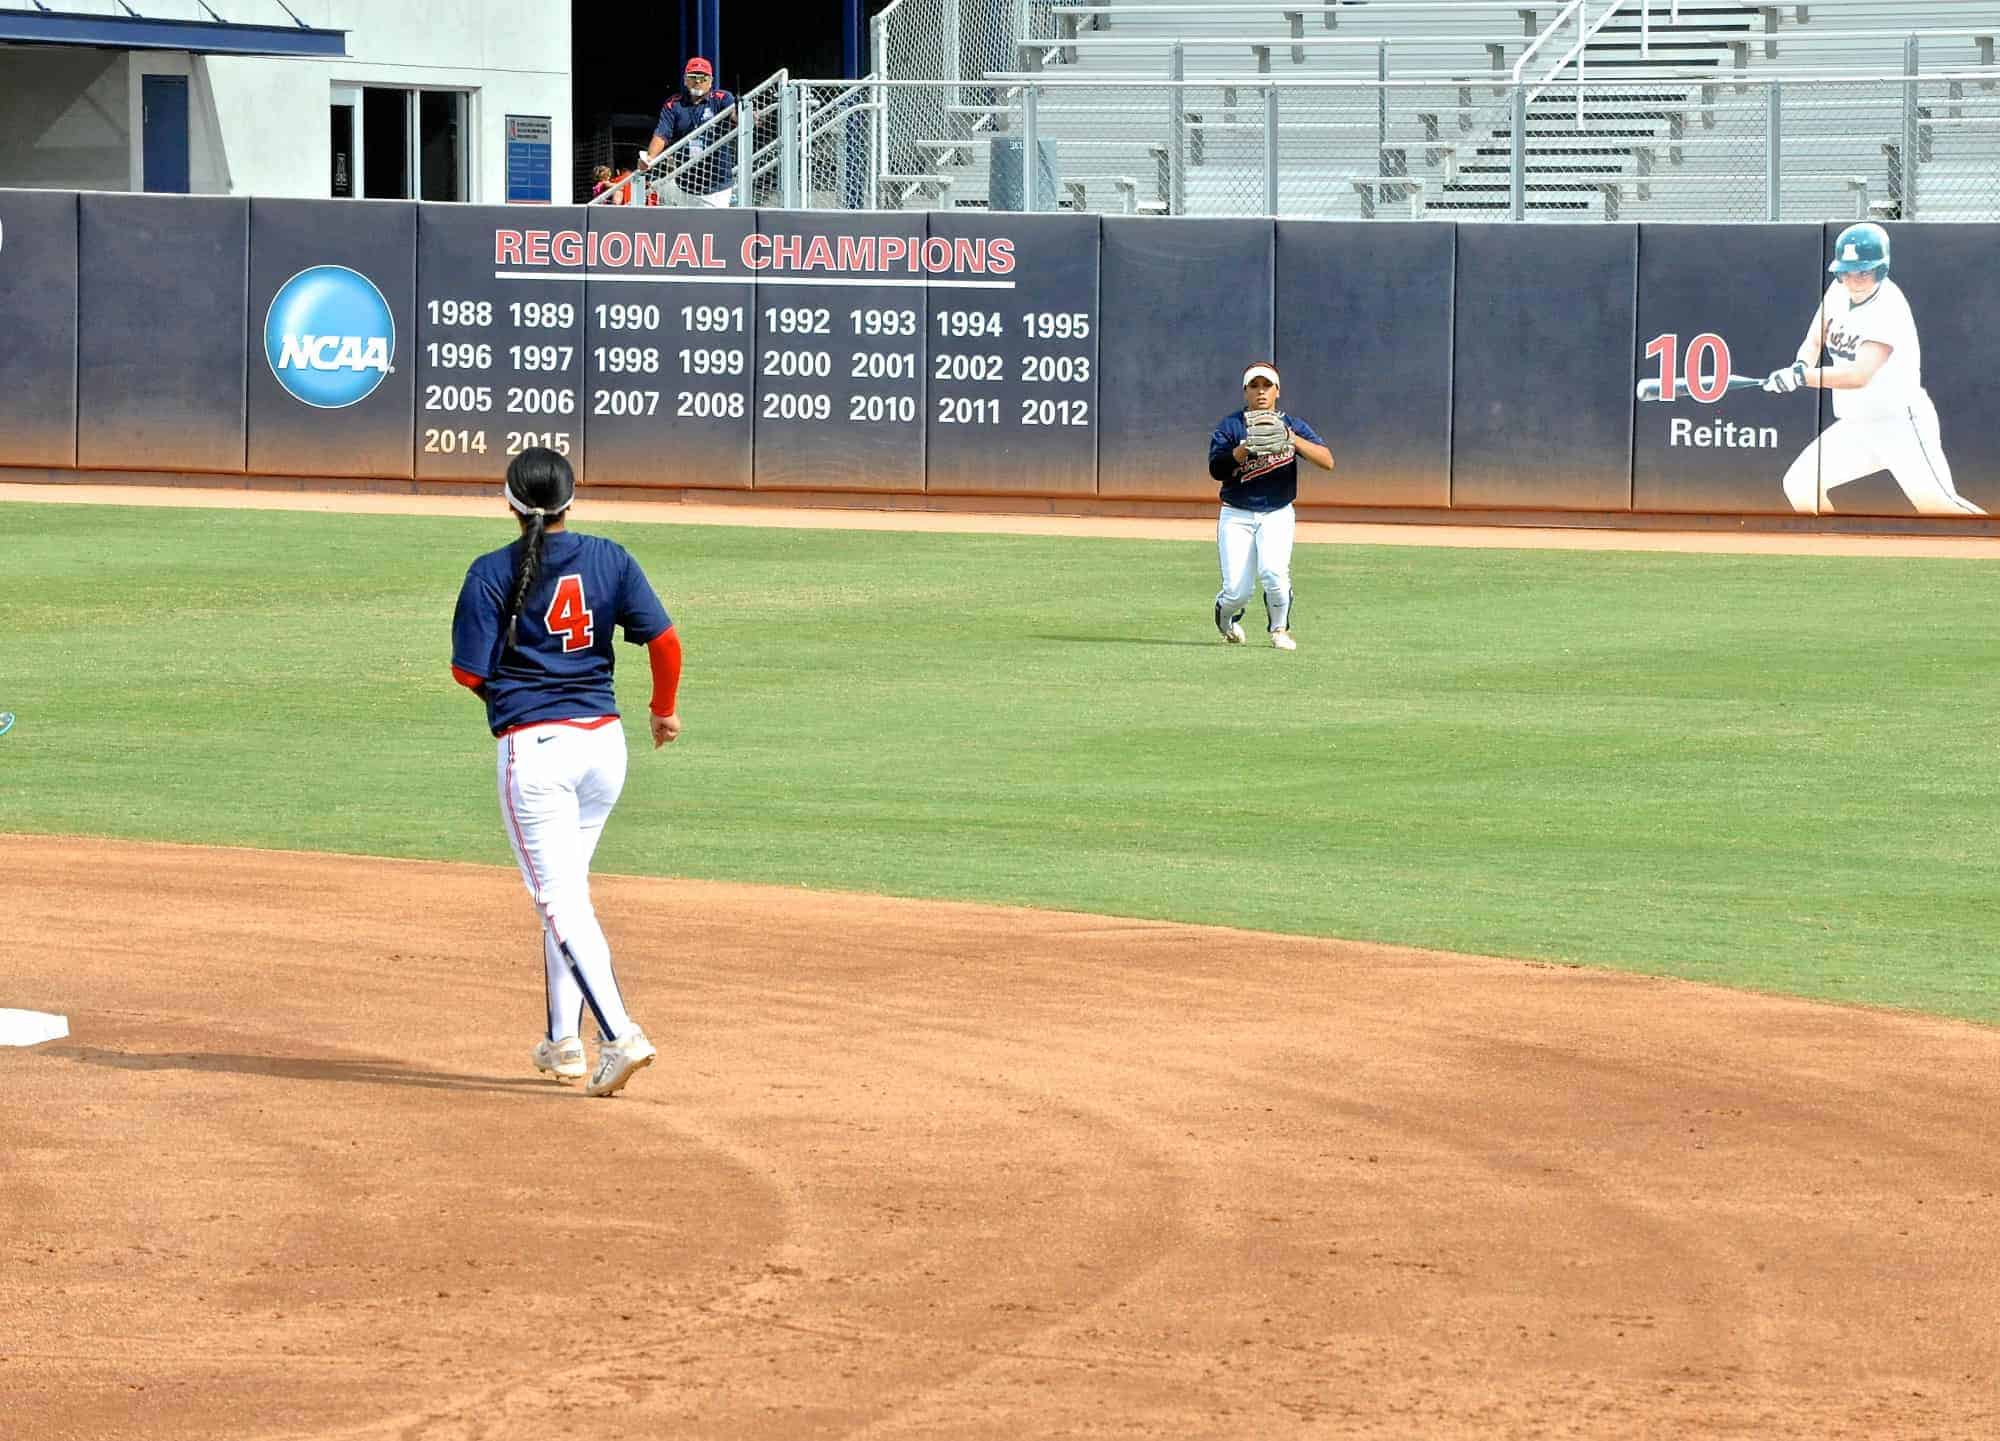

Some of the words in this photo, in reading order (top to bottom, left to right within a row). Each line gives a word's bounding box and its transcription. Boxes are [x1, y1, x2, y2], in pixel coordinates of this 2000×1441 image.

[495, 230, 726, 268] REGIONAL
[741, 234, 1016, 274] CHAMPIONS
[428, 300, 492, 326] 1988
[510, 303, 574, 328] 1989
[595, 304, 659, 329] 1990
[681, 306, 743, 331] 1991
[766, 308, 830, 333] 1992
[850, 310, 915, 335] 1993
[937, 312, 1003, 336] 1994
[1023, 313, 1089, 339] 1995
[278, 335, 389, 372] NCAA
[427, 343, 492, 369] 1996
[510, 346, 573, 370] 1997
[595, 347, 658, 372] 1998
[679, 349, 743, 374] 1999
[764, 351, 831, 376] 2000
[852, 353, 914, 378] 2001
[936, 355, 1003, 380] 2002
[1022, 356, 1089, 382] 2003
[1645, 333, 1731, 403] 10
[425, 385, 492, 411] 2005
[507, 388, 574, 414] 2006
[594, 390, 659, 415] 2007
[677, 392, 744, 417] 2008
[763, 393, 830, 419] 2009
[850, 396, 915, 421] 2010
[939, 398, 999, 424] 2011
[1022, 400, 1088, 425] 2012
[425, 429, 487, 454] 2014
[1671, 418, 1778, 448] Reitan
[545, 574, 593, 653] 4
